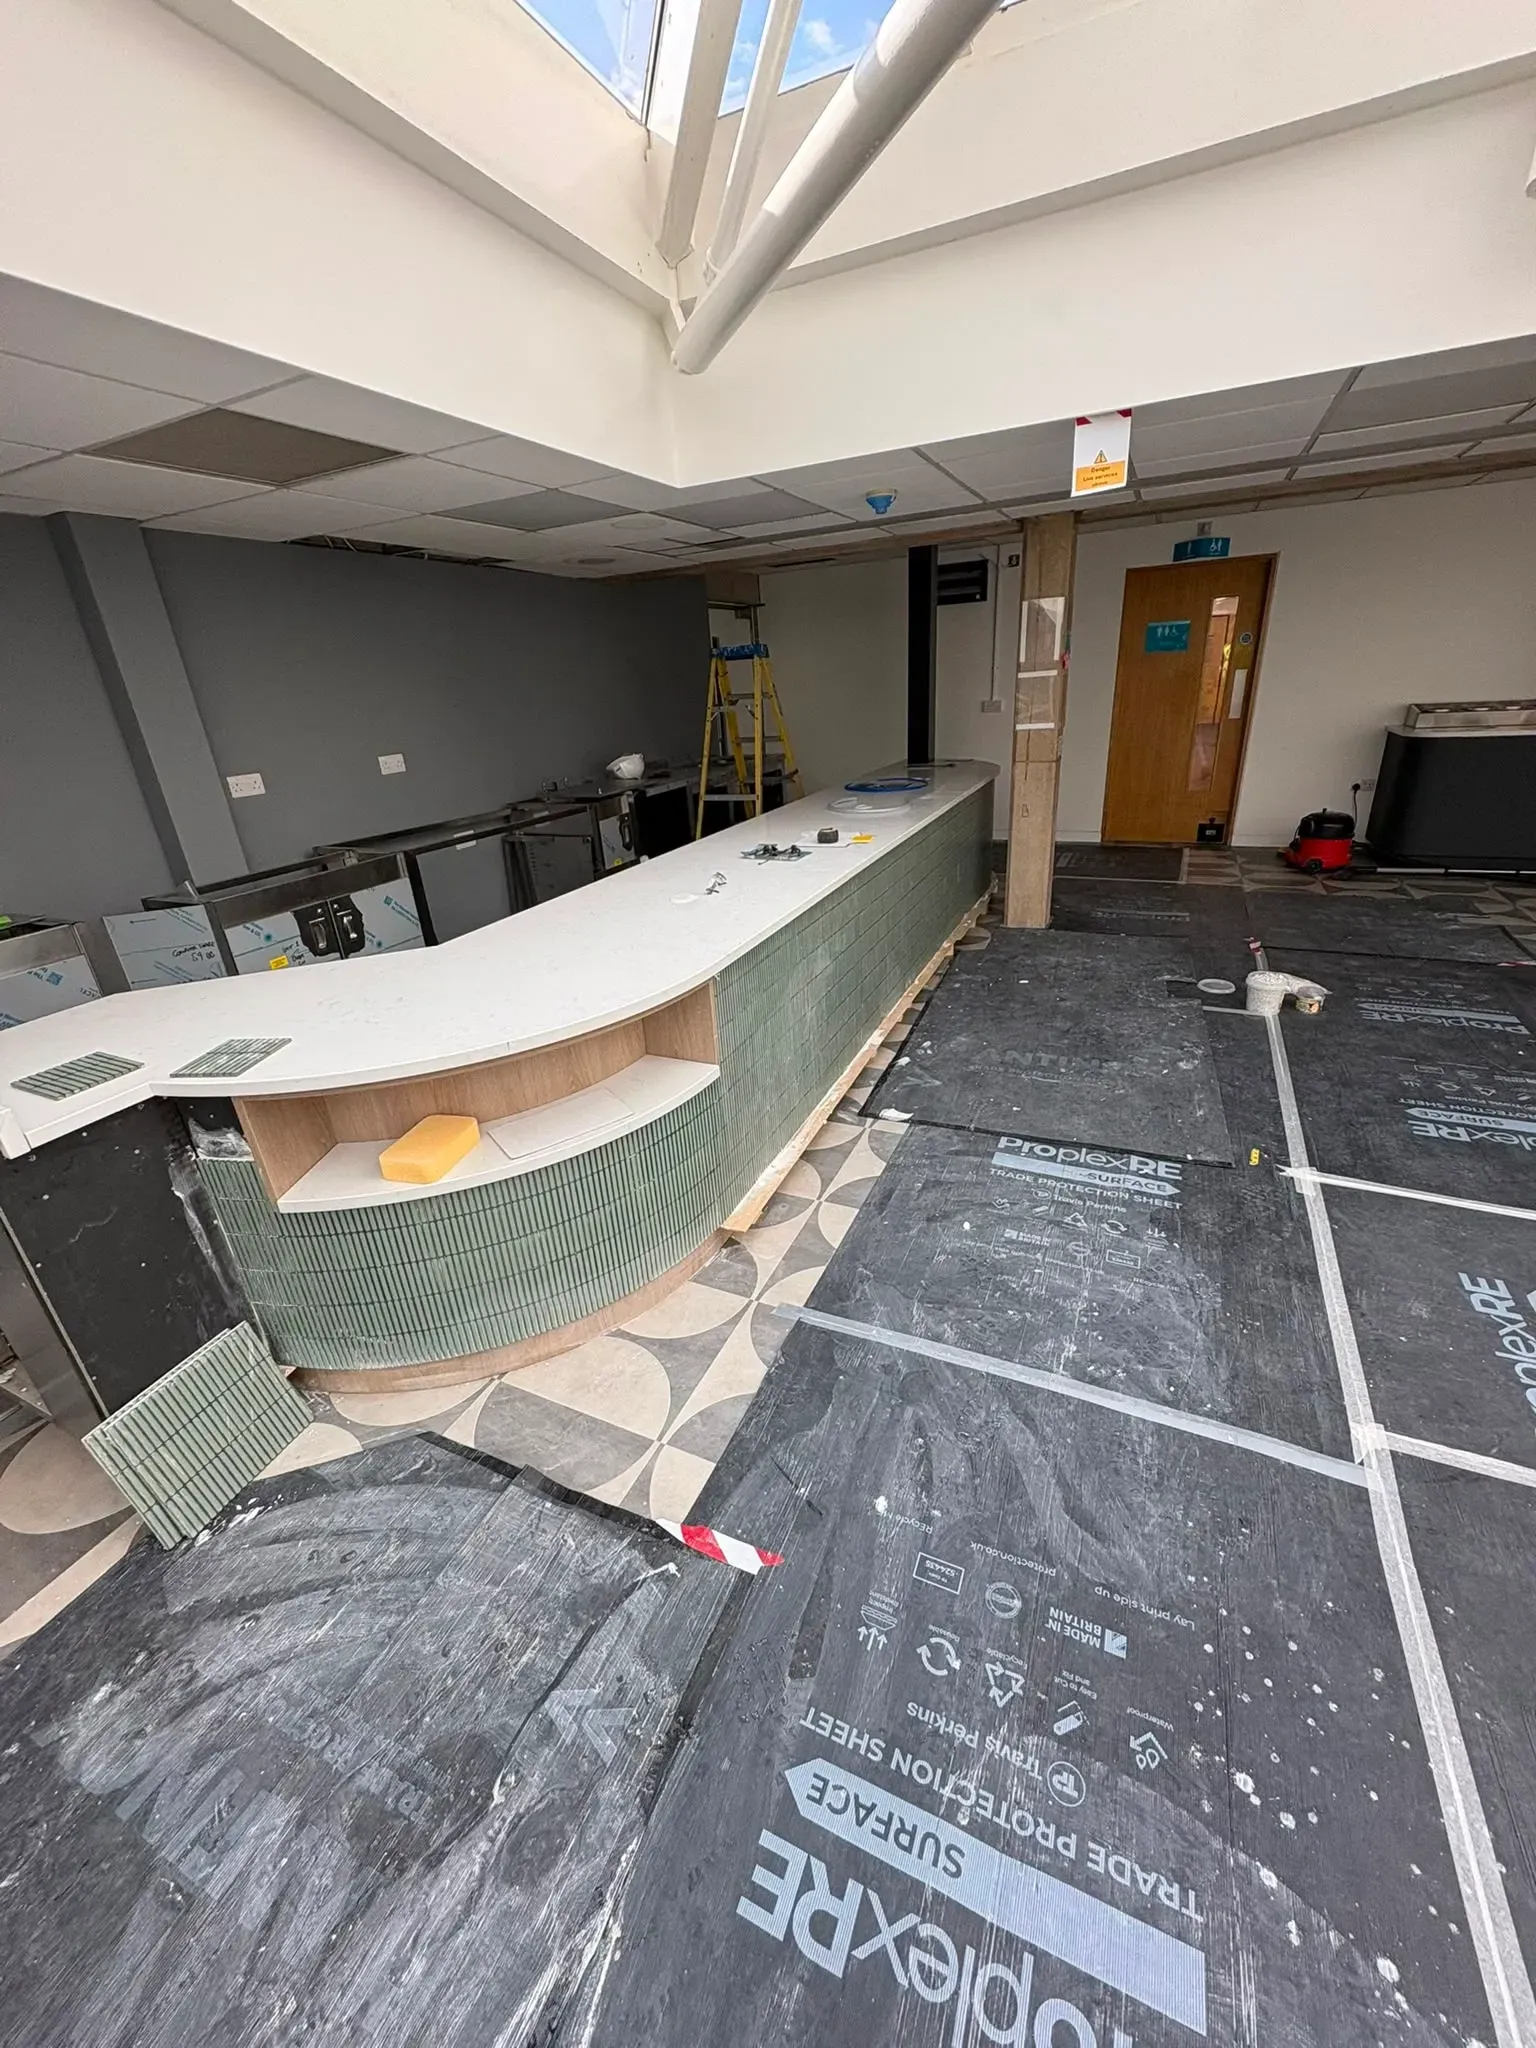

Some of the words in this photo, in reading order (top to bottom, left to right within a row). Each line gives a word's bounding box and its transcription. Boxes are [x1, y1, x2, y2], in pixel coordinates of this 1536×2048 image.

[1420, 1109, 1504, 1126] SURFACE
[990, 1168, 1034, 1183] TRADE
[1038, 1178, 1129, 1200] PROTECTION
[1133, 1194, 1183, 1210] SHEET
[1087, 1172, 1167, 1193] SURFACE
[970, 1540, 1056, 1577] protection.co.uk
[1094, 1586, 1111, 1598] up
[1113, 1593, 1138, 1609] side
[1049, 1606, 1102, 1636] BRITAIN
[1140, 1605, 1171, 1621] print
[1173, 1614, 1195, 1631] Lay
[1047, 1618, 1061, 1633] IN
[1063, 1624, 1101, 1649] MADE
[1054, 1676, 1068, 1688] Cut
[1062, 1670, 1074, 1681] Fix
[1075, 1674, 1091, 1686] and
[1069, 1682, 1078, 1692] to
[1079, 1685, 1097, 1700] Easy
[907, 1701, 979, 1749] Perkins
[1127, 1706, 1174, 1732] Waterproof
[799, 1706, 886, 1763] SHEET
[985, 1735, 1042, 1781] Travis
[890, 1746, 1077, 1861] PROTECTION
[805, 1772, 966, 1879] SURFACE
[1087, 1839, 1204, 1923] TRADE
